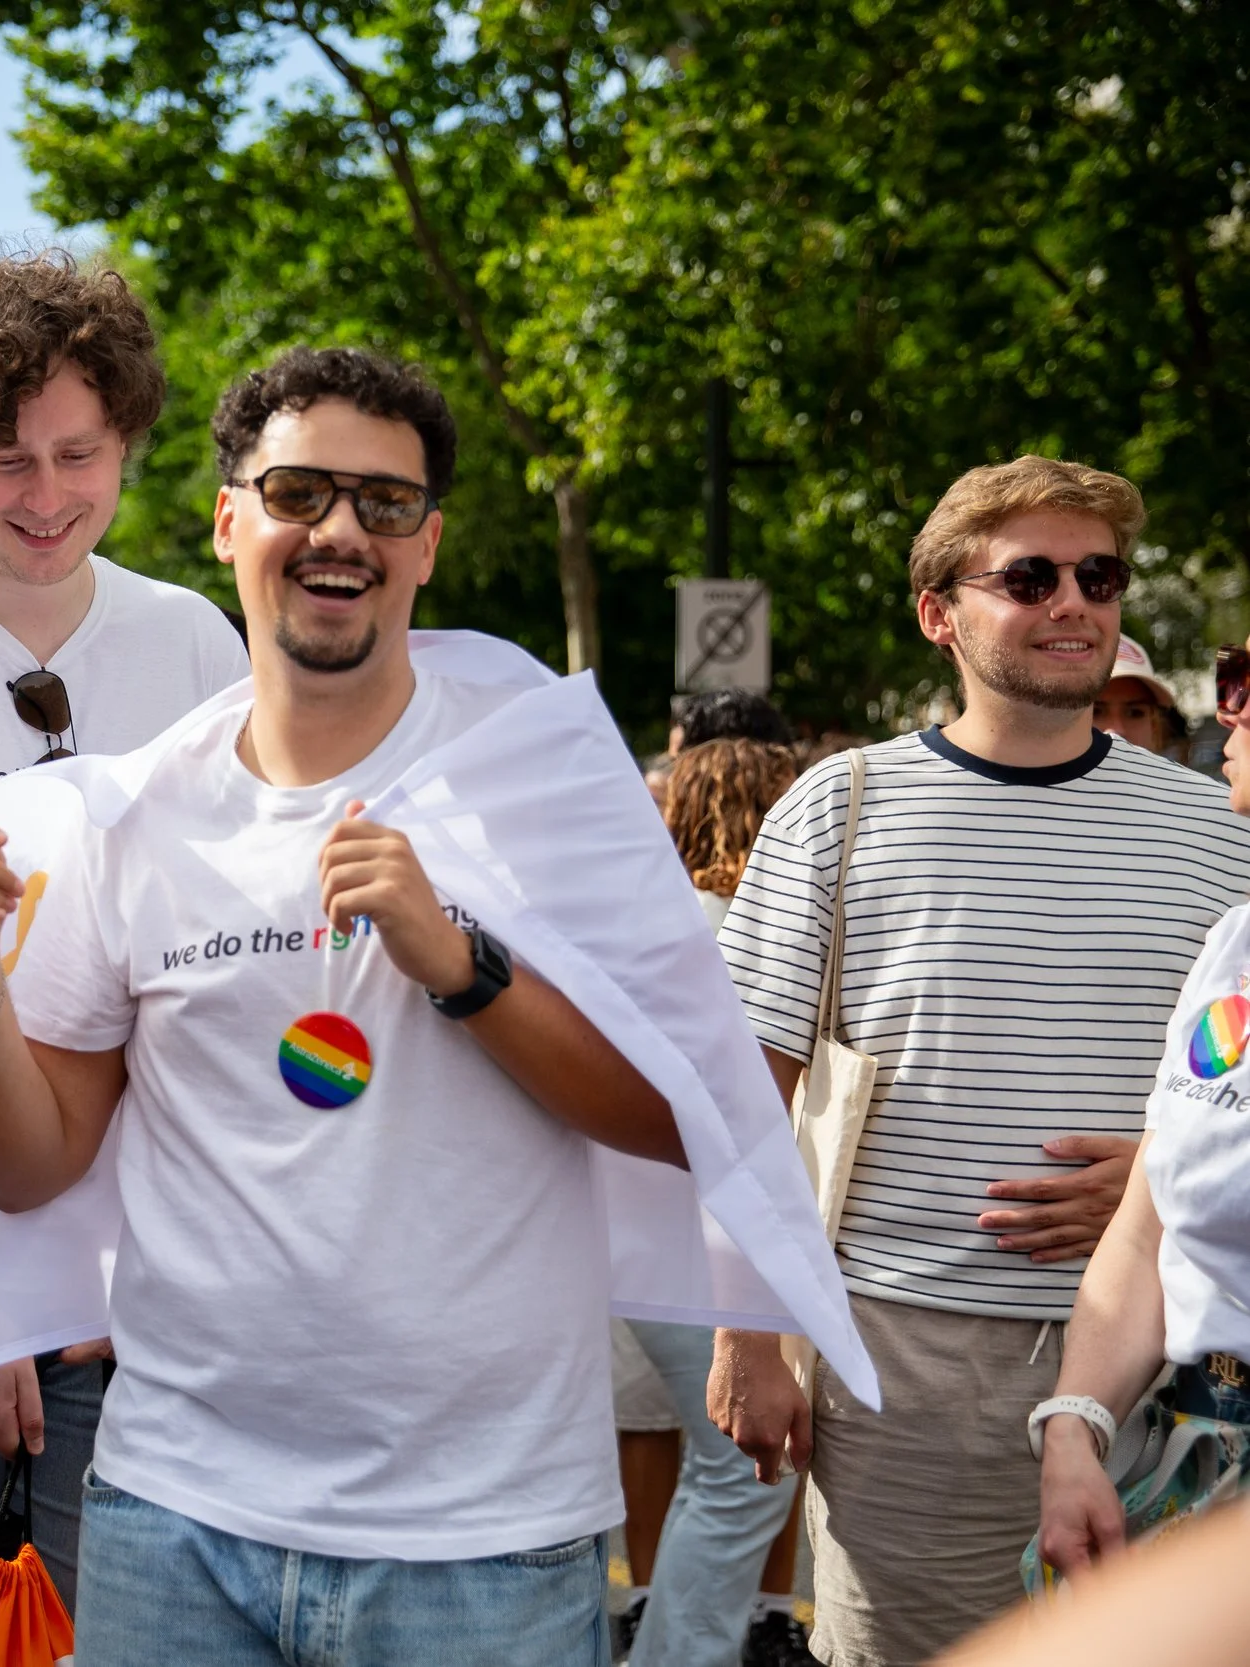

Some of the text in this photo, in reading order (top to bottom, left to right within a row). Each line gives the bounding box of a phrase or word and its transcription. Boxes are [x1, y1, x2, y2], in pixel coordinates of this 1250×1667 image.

[163, 914, 371, 970] we do the rgh
[1165, 1072, 1191, 1093] we
